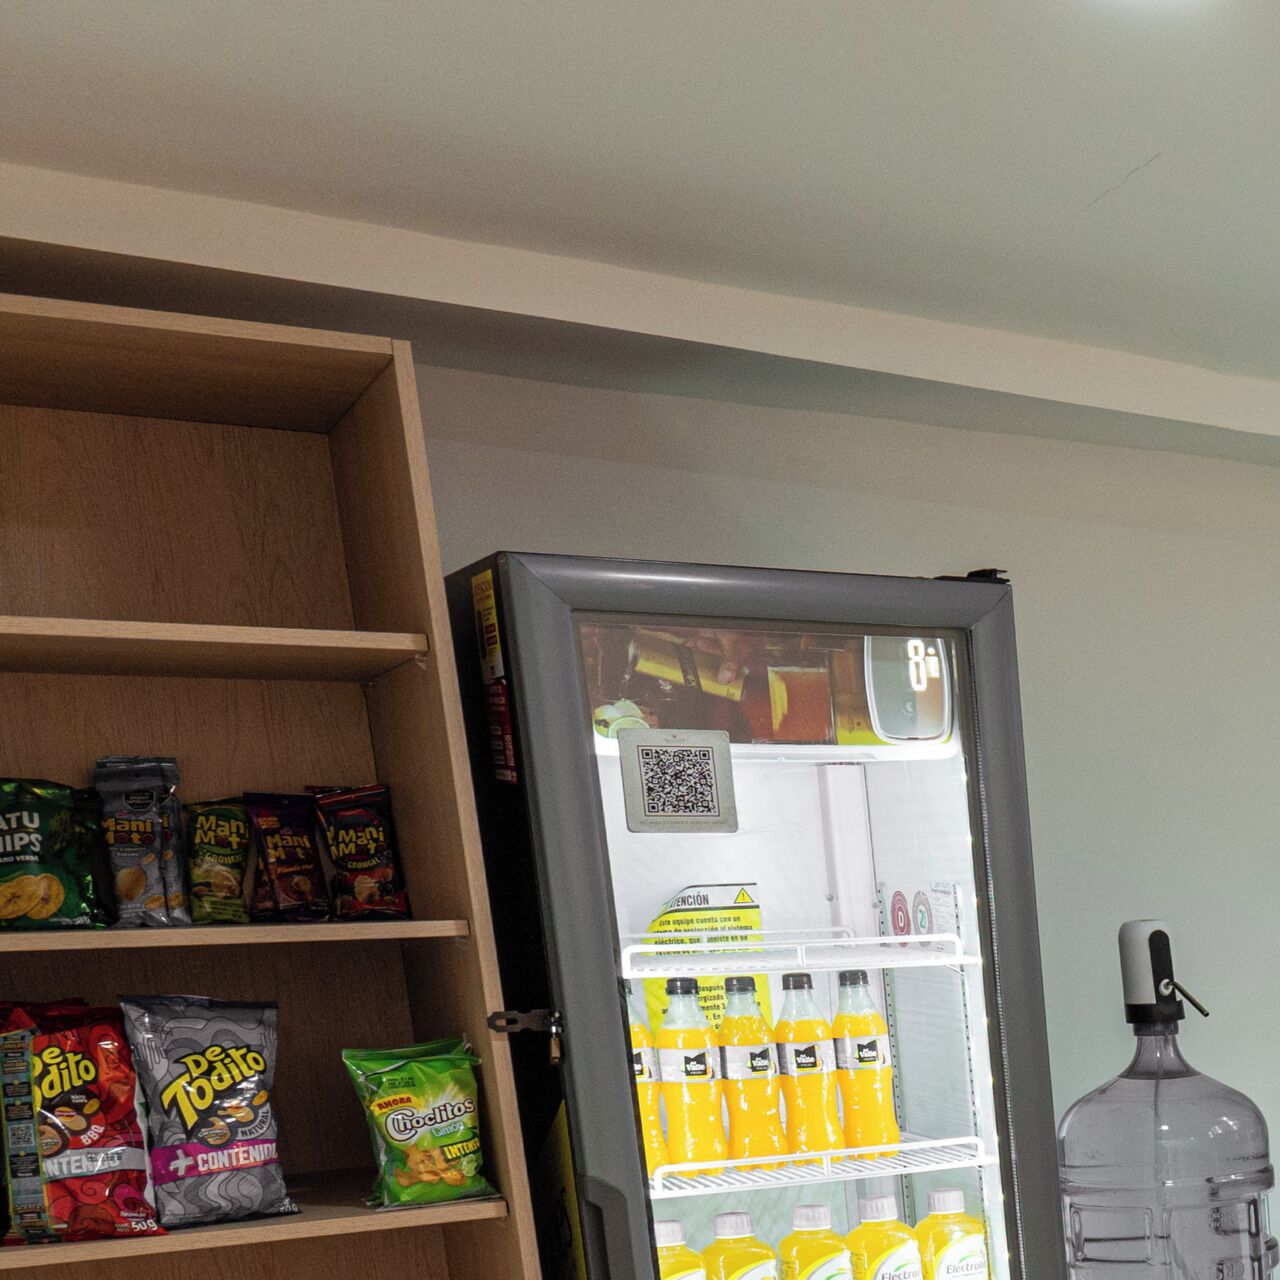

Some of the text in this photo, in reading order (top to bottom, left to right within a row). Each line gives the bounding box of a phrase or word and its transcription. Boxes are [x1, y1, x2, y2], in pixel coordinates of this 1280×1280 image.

[696, 916, 718, 924] cuenta
[179, 1047, 225, 1077] De
[161, 1047, 265, 1130] Todito
[377, 1097, 412, 1110] AHORA
[240, 1109, 271, 1137] NATURAL
[386, 1099, 475, 1142] Choclitos
[80, 1124, 105, 1146] BBQ
